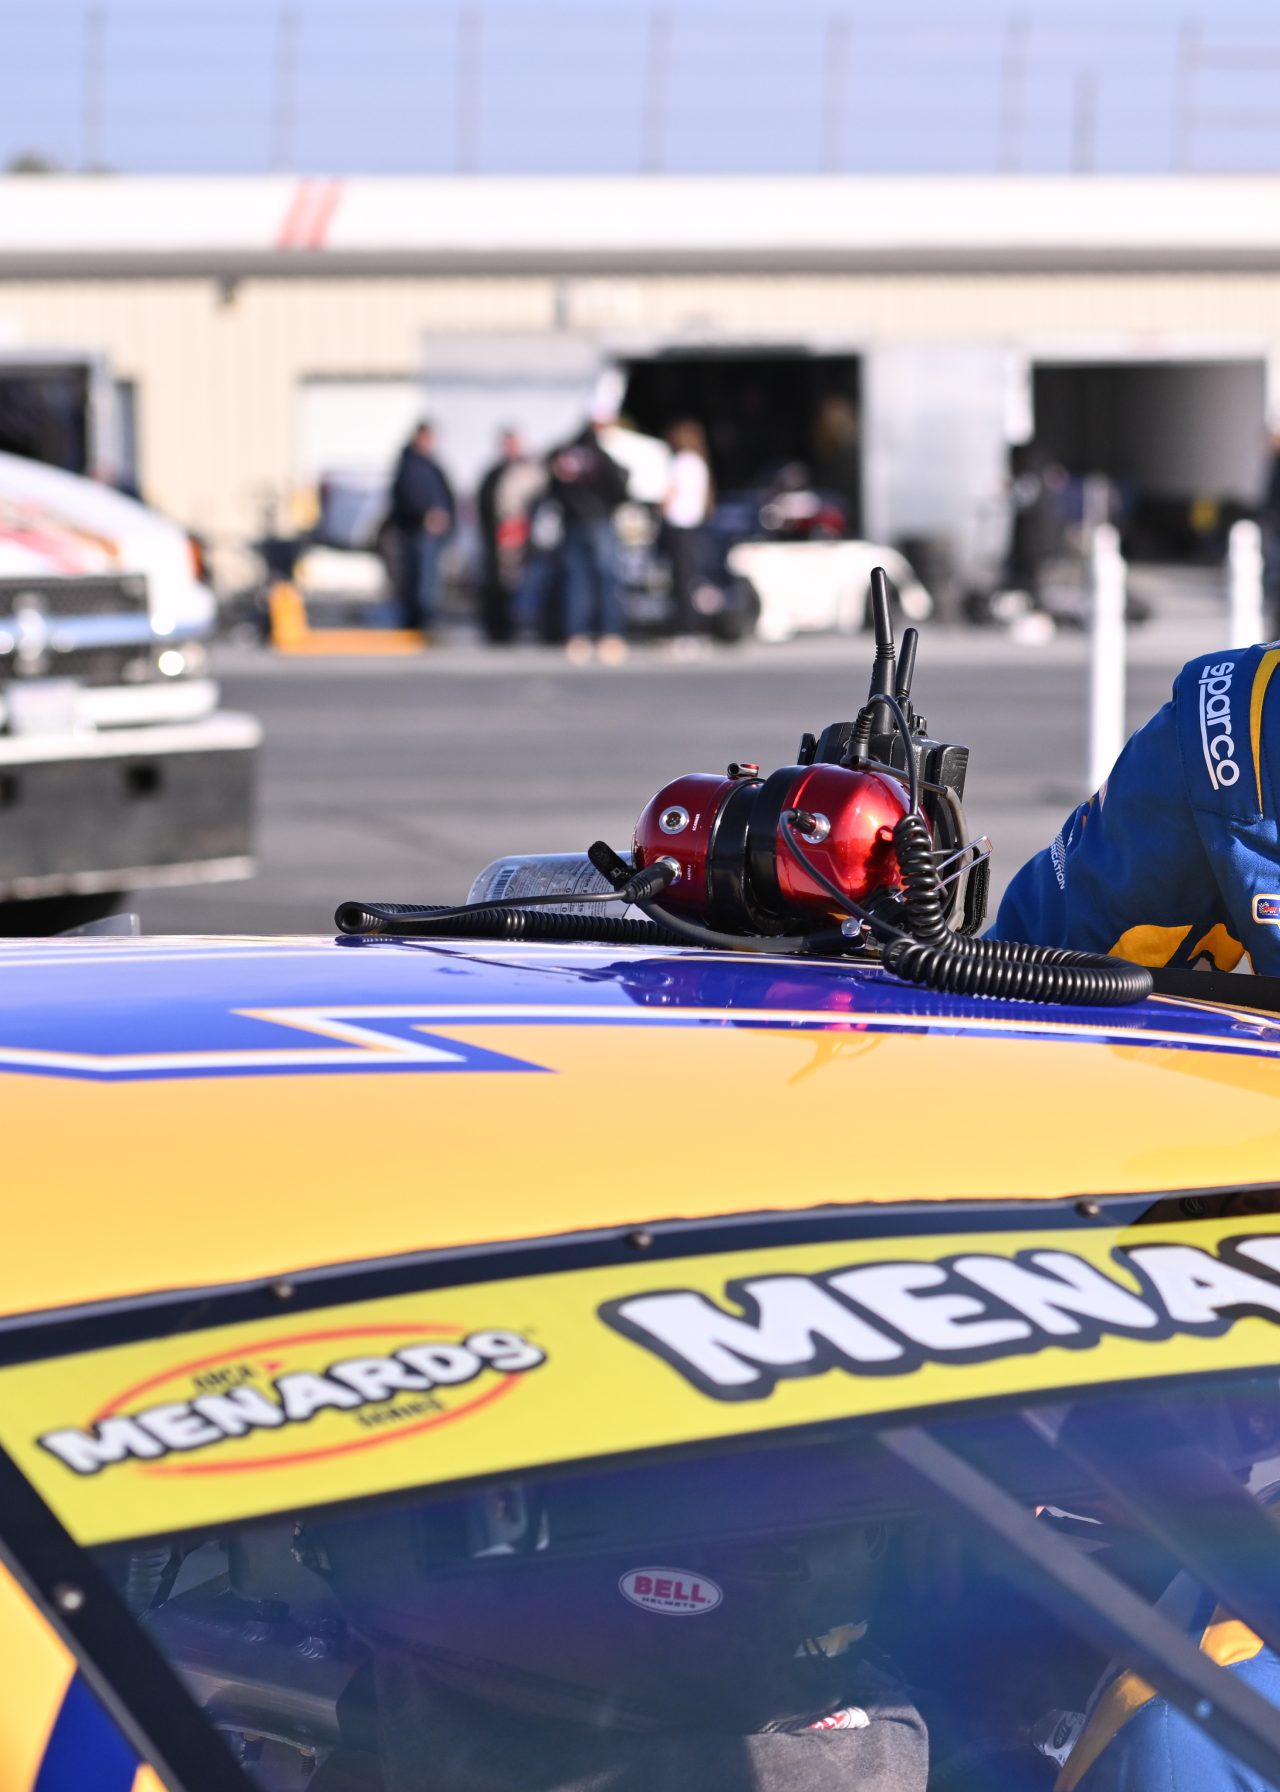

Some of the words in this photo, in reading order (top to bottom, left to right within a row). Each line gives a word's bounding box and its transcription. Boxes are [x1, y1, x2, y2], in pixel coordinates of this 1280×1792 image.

[1199, 662, 1241, 788] sparco
[36, 1331, 546, 1474] MENARDS
[634, 1575, 706, 1604] BELL
